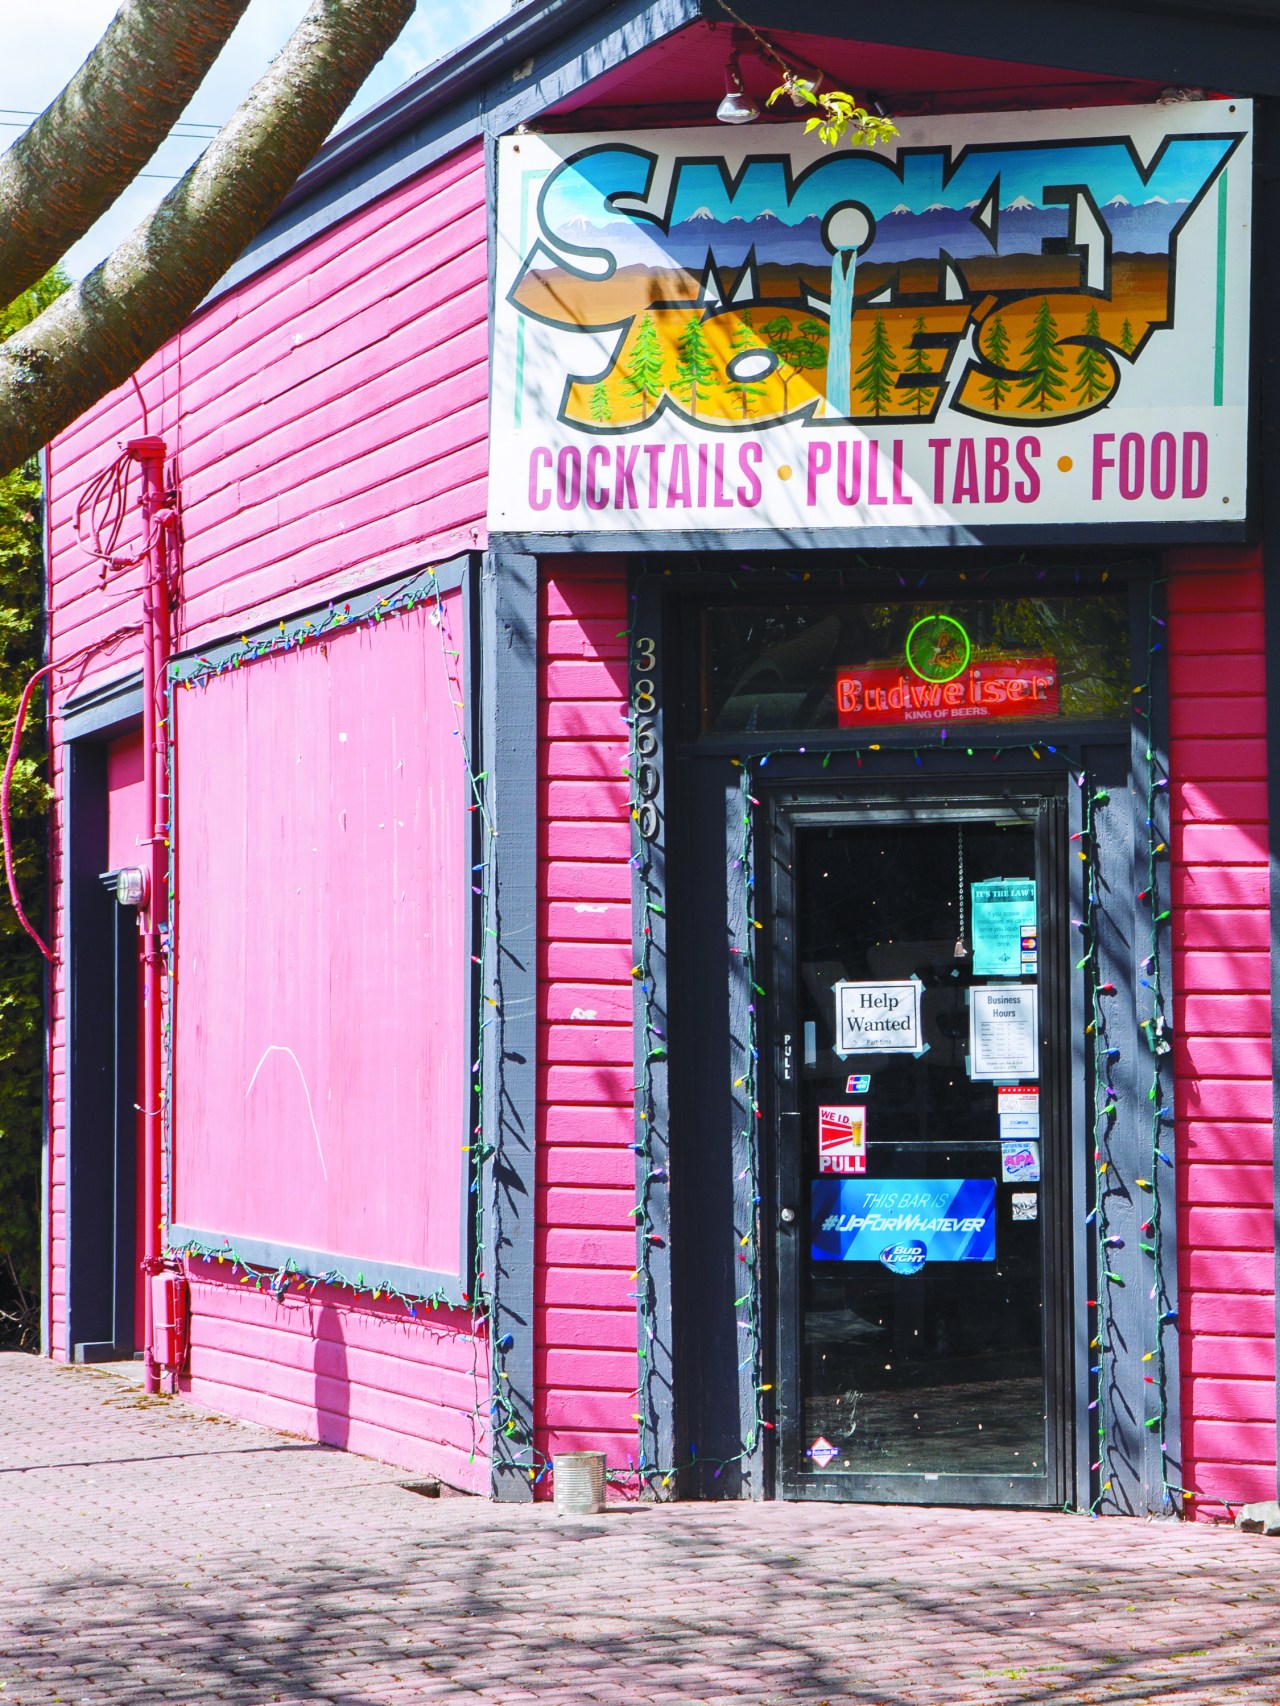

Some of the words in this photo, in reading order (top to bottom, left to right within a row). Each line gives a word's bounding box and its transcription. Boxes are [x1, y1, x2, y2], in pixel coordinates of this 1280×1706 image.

[506, 132, 1248, 363] SMOKEY
[528, 441, 763, 511] COCKTAILS
[806, 439, 913, 506] PULL
[928, 436, 1041, 504] TABS
[1092, 432, 1208, 500] FOOD
[837, 668, 1055, 713] Budweiser
[904, 710, 932, 720] KING
[935, 709, 949, 718] OF
[634, 637, 657, 838] 38600
[976, 890, 991, 898] IT'S
[993, 890, 1009, 898] THE
[860, 993, 899, 1012] Help
[987, 995, 1021, 1005] Business
[993, 1008, 1016, 1018] Hours
[847, 1016, 911, 1032] Wanted
[821, 1109, 836, 1121] WE
[819, 1156, 865, 1172] PULL
[863, 1193, 897, 1208] THIS
[898, 1193, 931, 1208] BAR
[931, 1193, 949, 1208] IS
[893, 1247, 922, 1255] BUD
[887, 1255, 926, 1263] LIGHT
